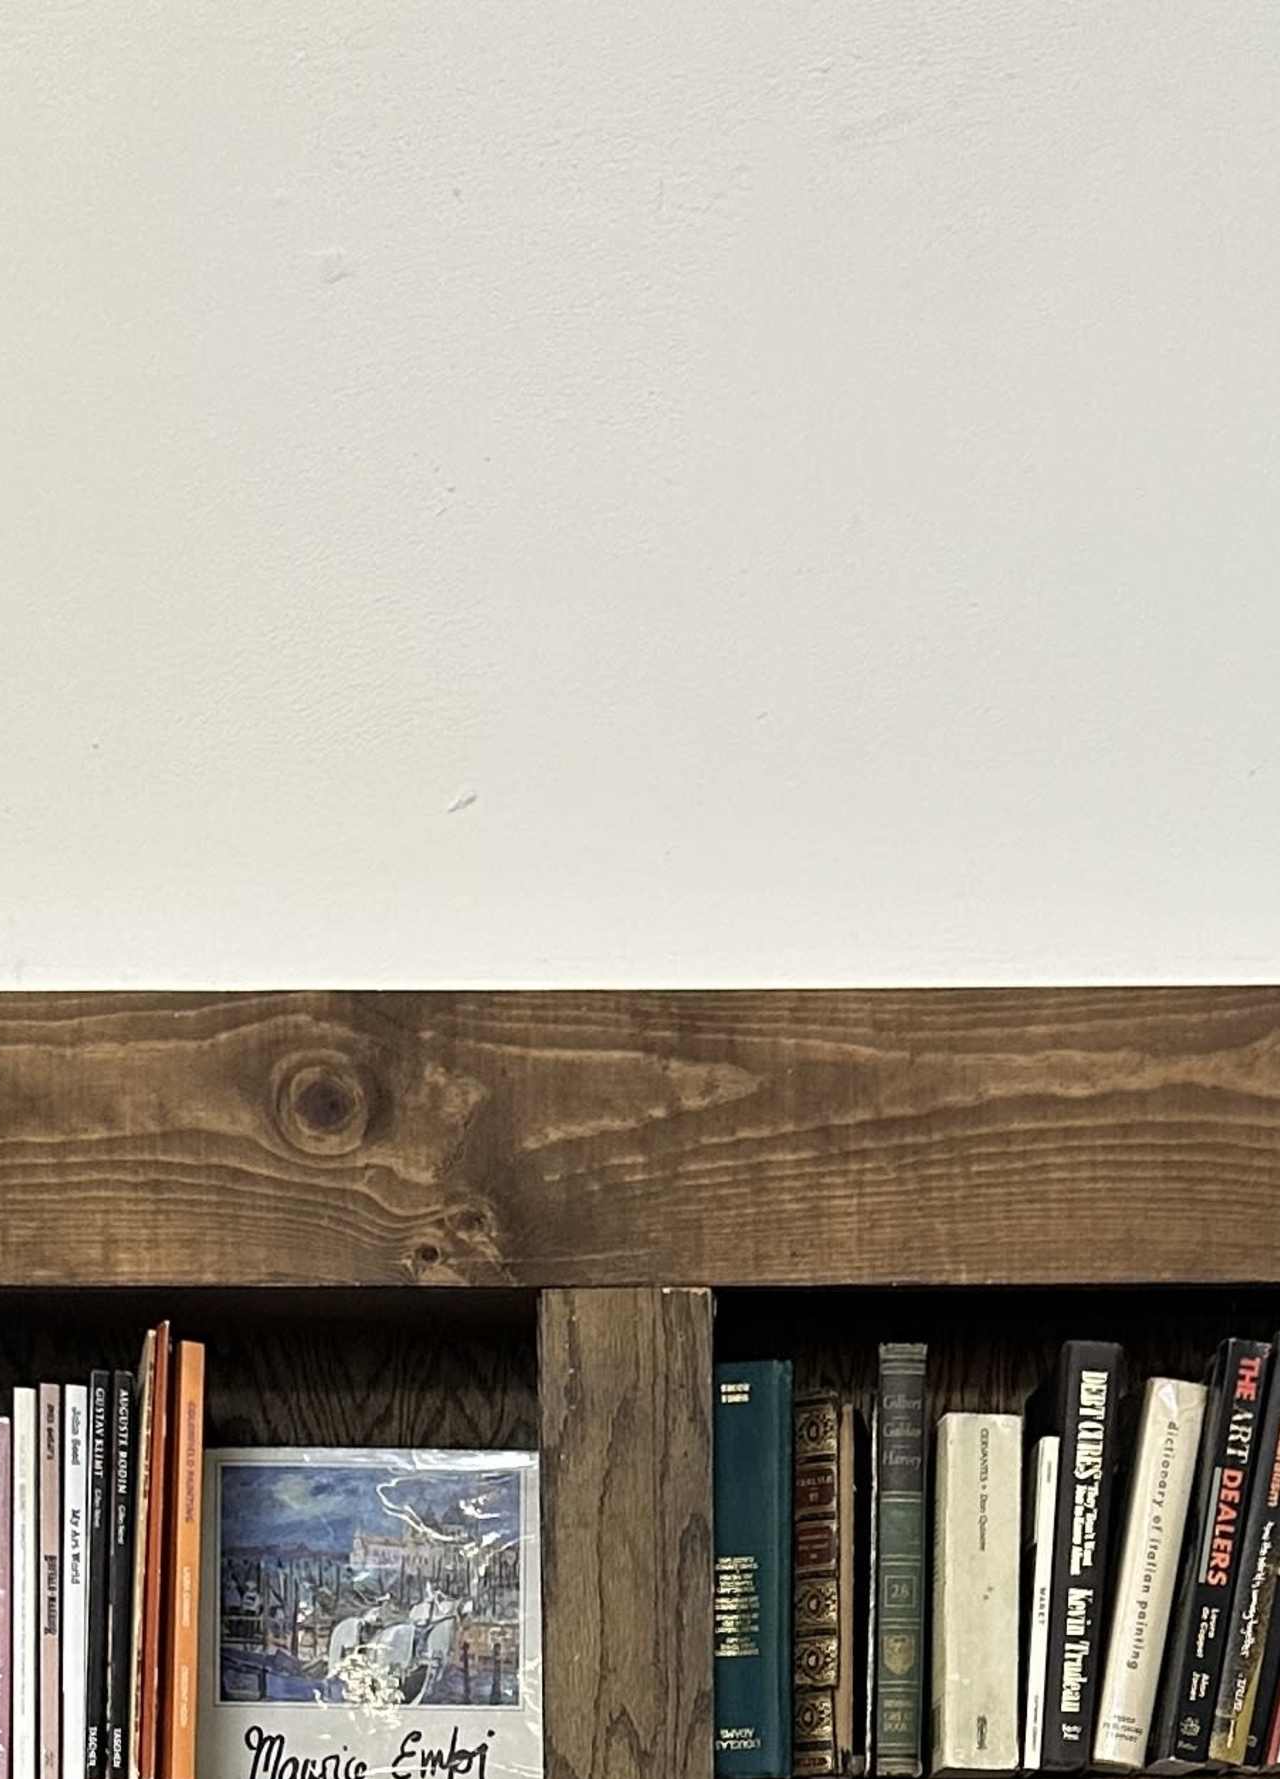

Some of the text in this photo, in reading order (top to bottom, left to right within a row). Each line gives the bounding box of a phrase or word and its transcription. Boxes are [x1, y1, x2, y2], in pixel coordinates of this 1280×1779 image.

[93, 1387, 105, 1479] GUSTAV KLIMT
[117, 1388, 129, 1494] AUGUSTE RODIN
[1074, 1371, 1109, 1480] DEBT CURES
[1207, 1356, 1263, 1587] THE ART DEALERS
[69, 1508, 81, 1527] My
[1126, 1420, 1179, 1670] dictionary of italian painting
[70, 1552, 81, 1585] World
[1066, 1588, 1093, 1636] Kevin
[1061, 1640, 1090, 1713] Trudeau
